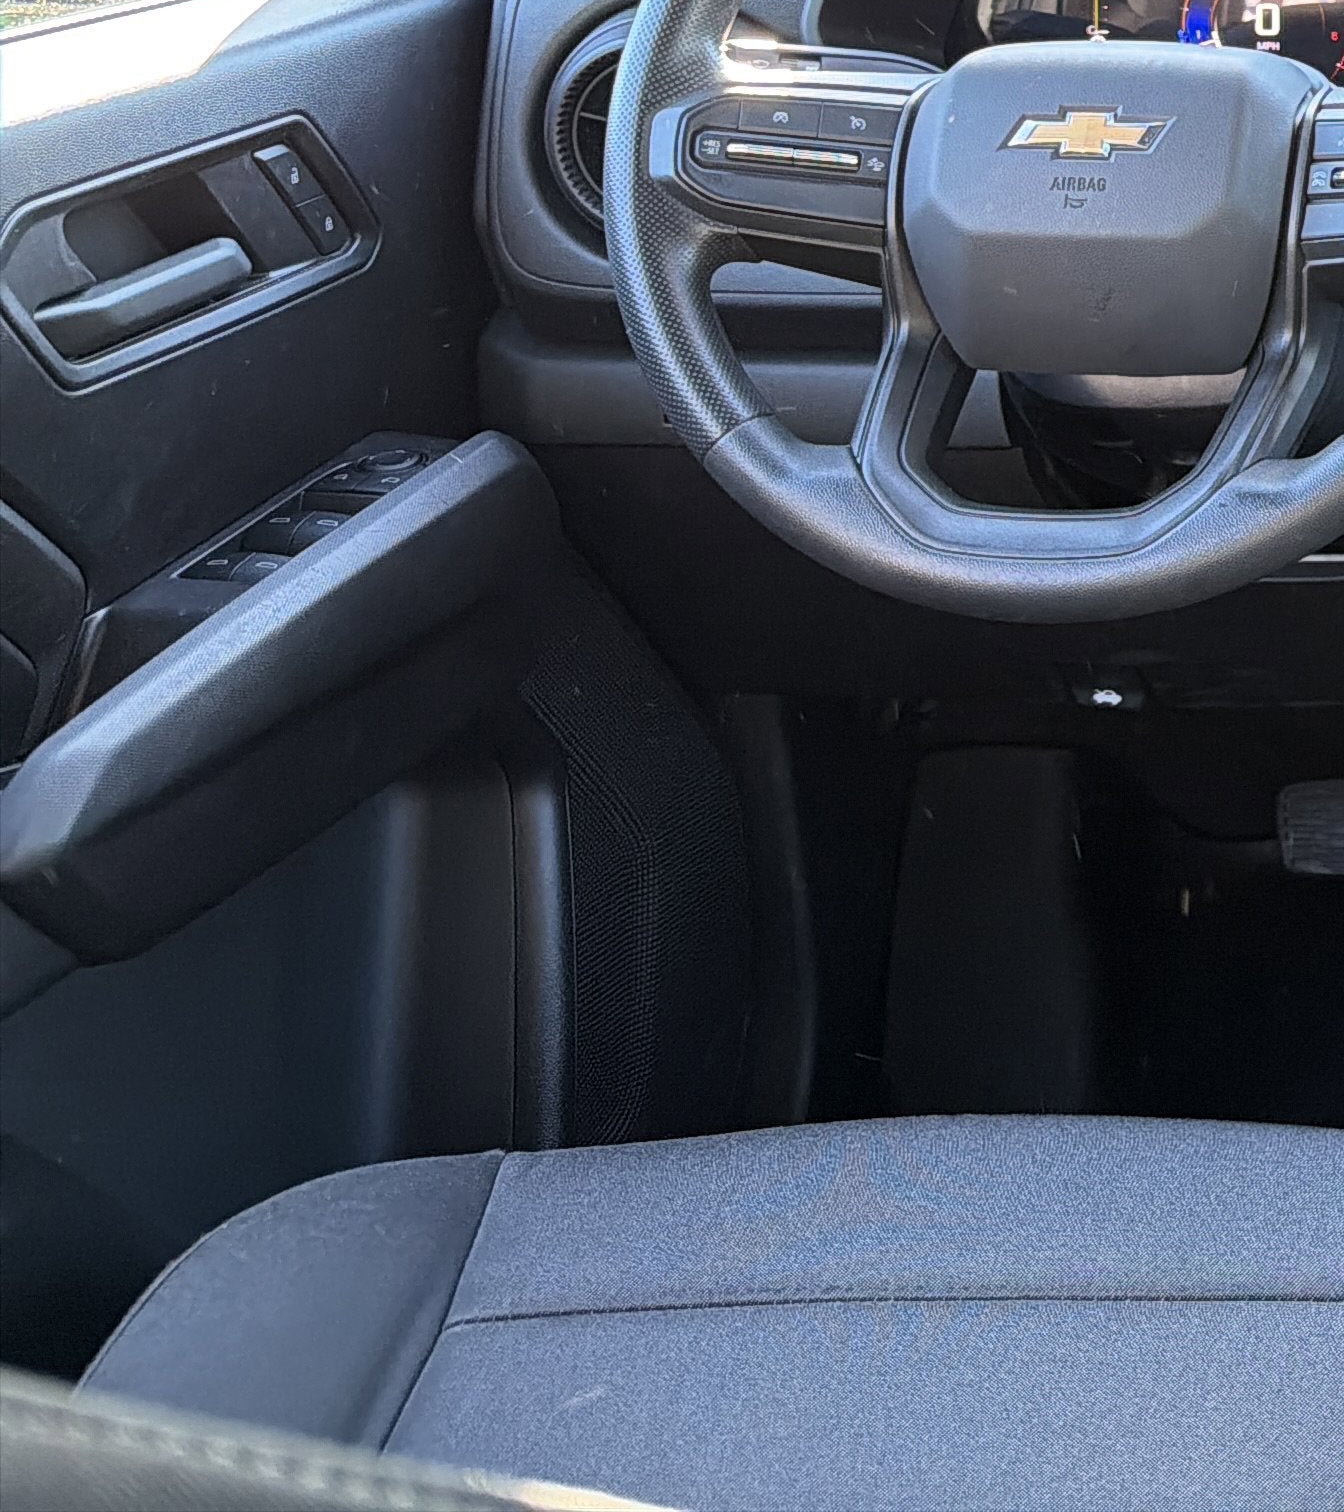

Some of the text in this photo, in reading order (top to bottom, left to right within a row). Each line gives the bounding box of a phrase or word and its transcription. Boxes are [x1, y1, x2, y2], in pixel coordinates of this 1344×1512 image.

[1254, 2, 1281, 37] 0
[1257, 41, 1281, 52] MPH
[1049, 176, 1107, 193] AIRBAG
